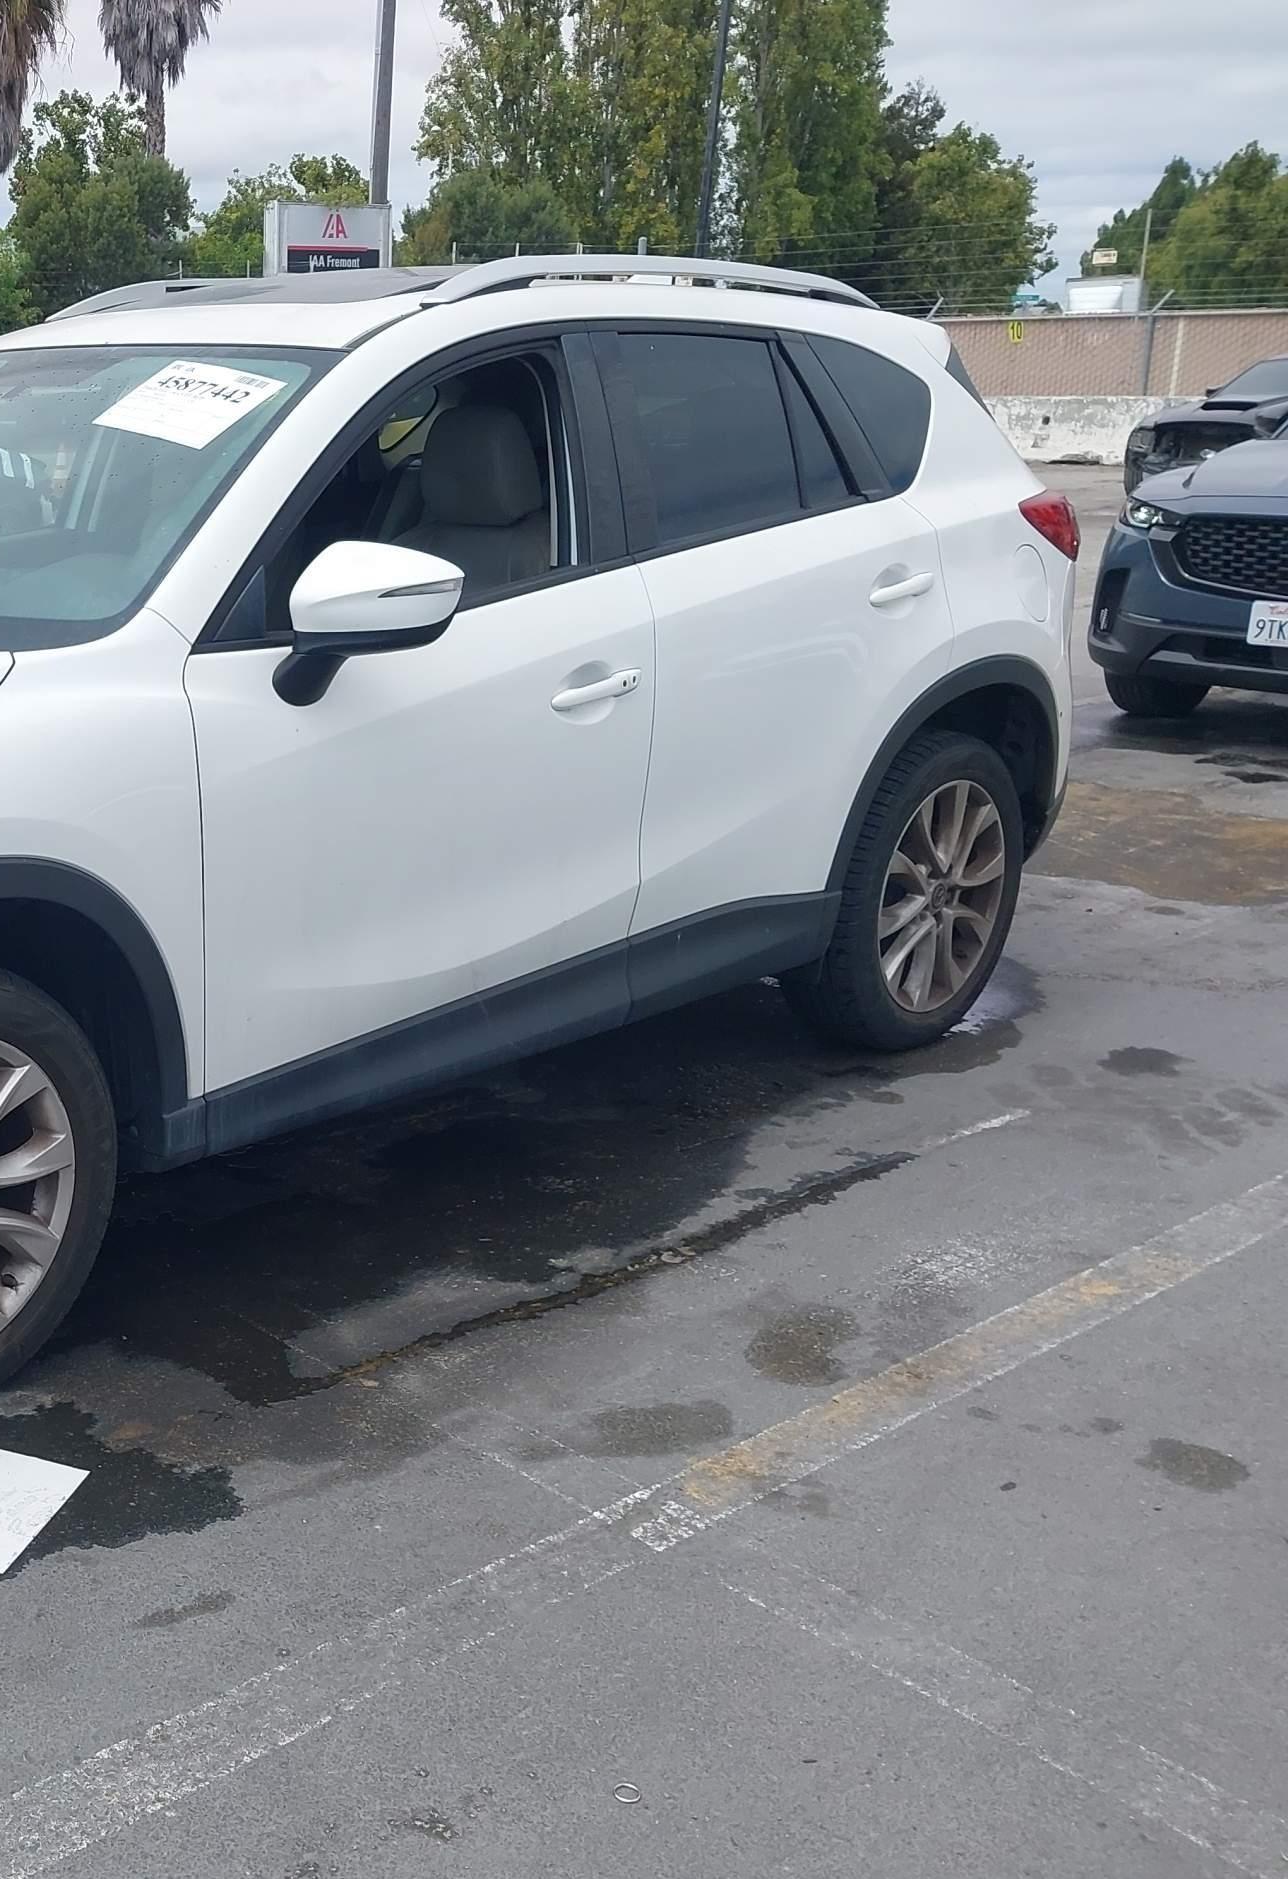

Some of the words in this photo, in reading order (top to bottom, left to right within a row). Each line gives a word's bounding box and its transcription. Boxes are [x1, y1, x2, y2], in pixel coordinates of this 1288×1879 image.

[326, 254, 360, 268] Fremont
[1010, 321, 1023, 341] 10
[158, 375, 251, 404] 45877442
